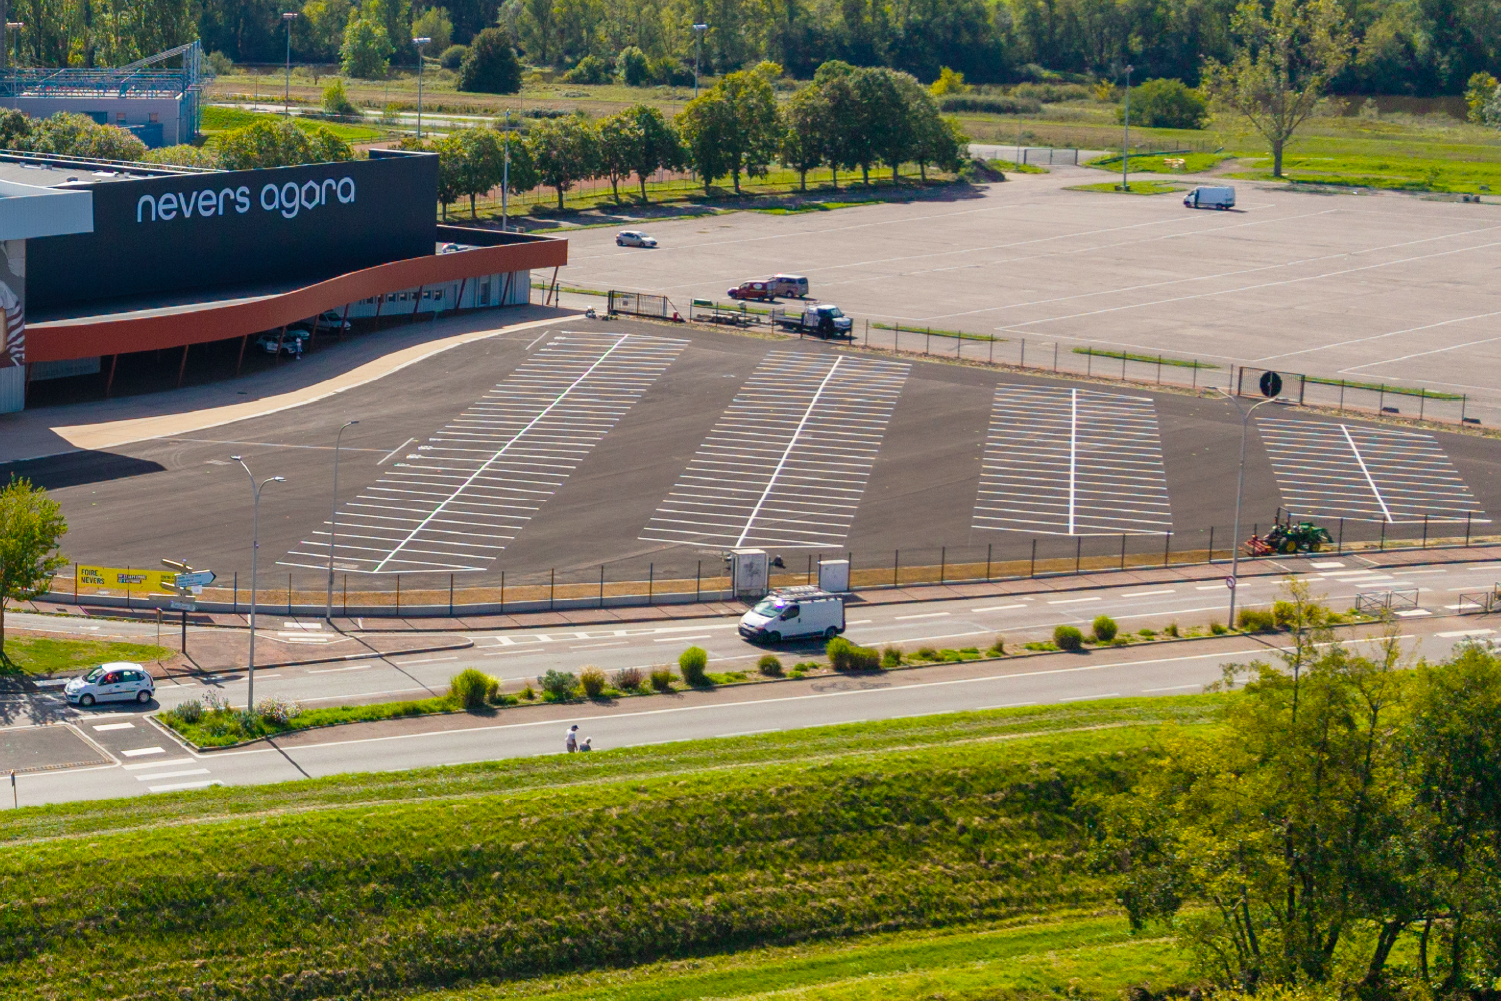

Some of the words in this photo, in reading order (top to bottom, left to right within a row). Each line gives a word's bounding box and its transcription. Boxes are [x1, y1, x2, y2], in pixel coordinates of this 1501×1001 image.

[137, 186, 250, 222] nevers
[260, 177, 355, 219] agora
[81, 568, 98, 577] FOIRE
[81, 576, 105, 585] NEVERS
